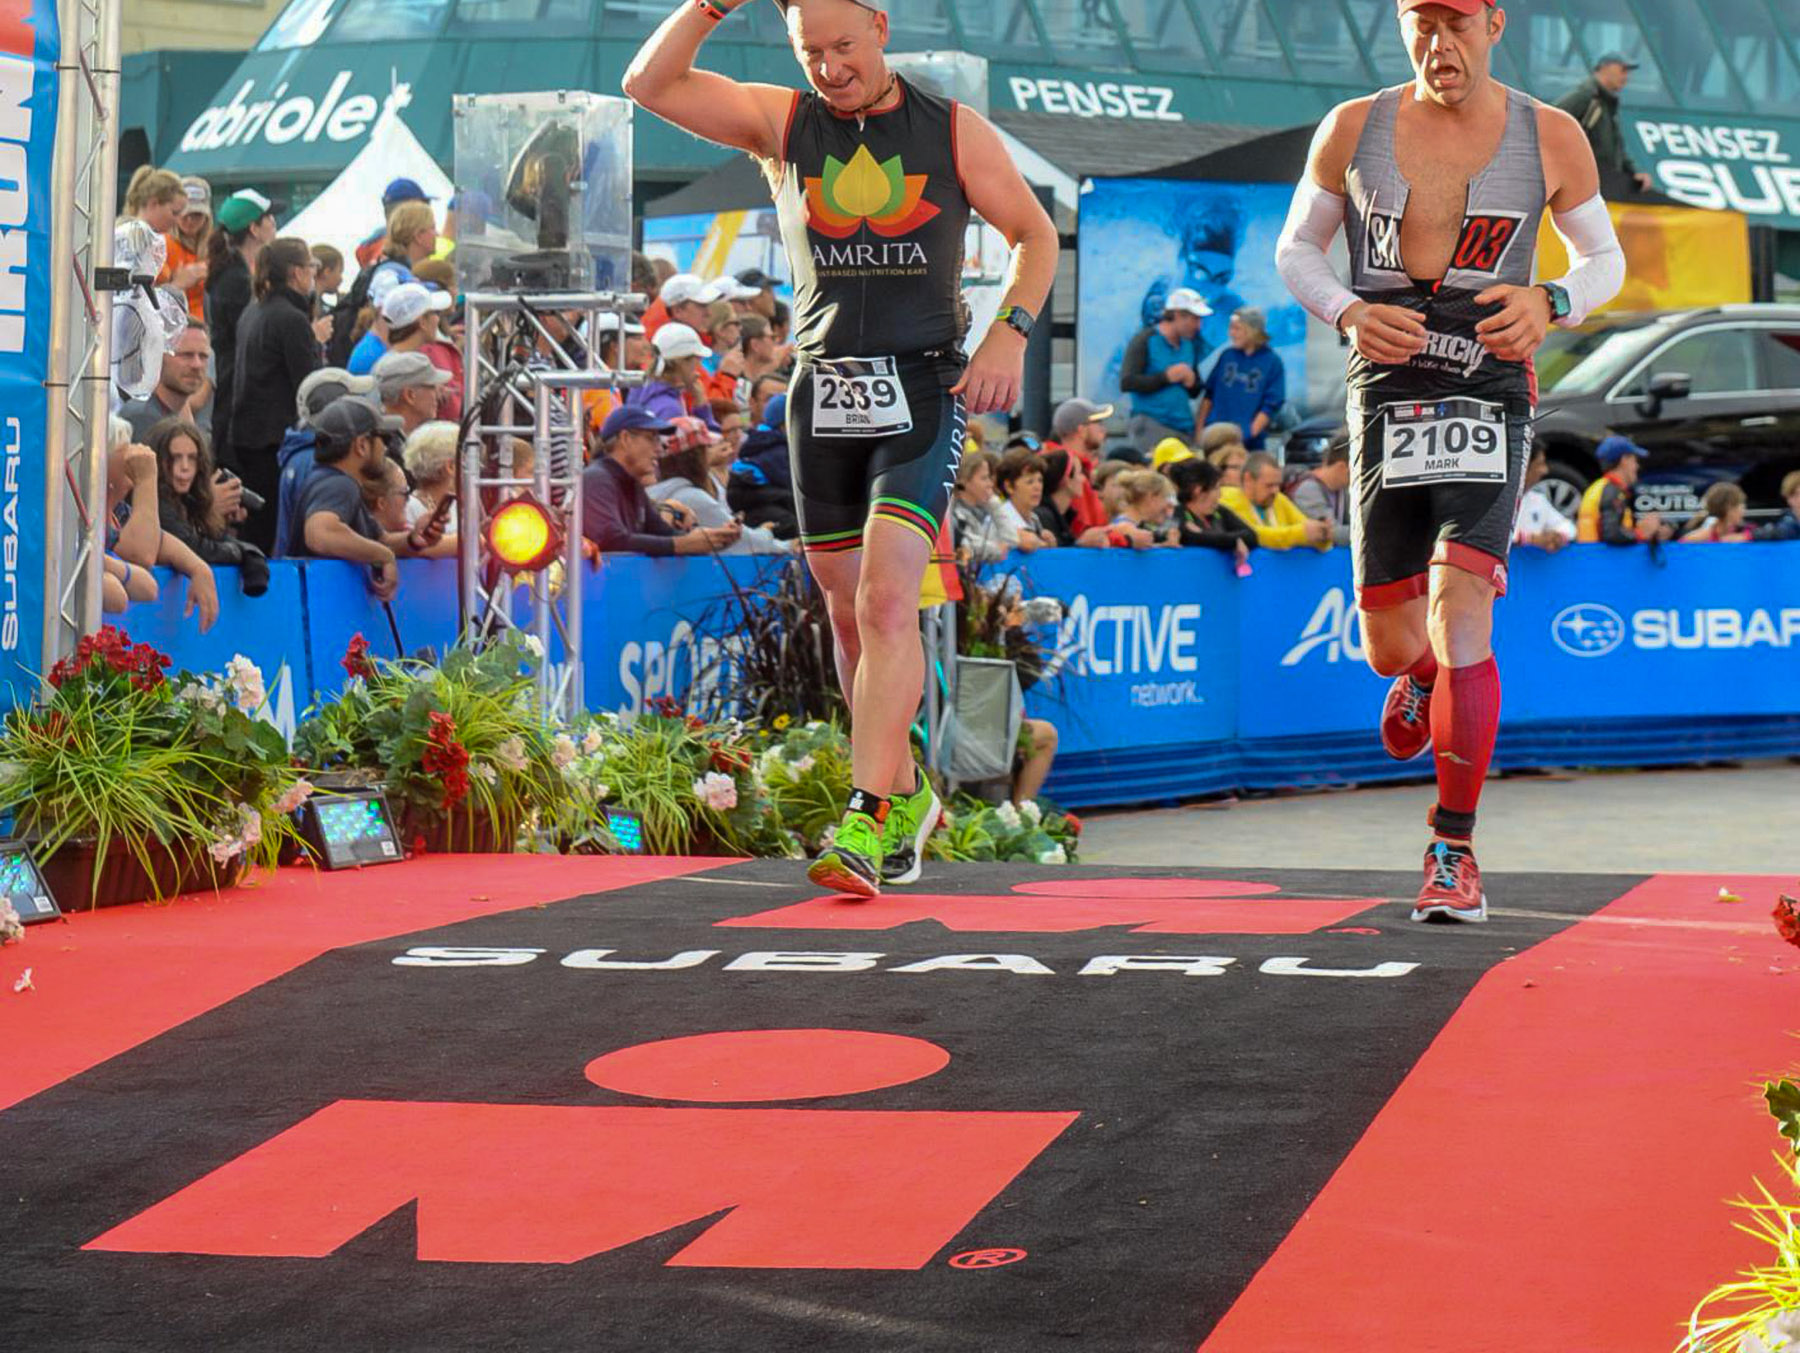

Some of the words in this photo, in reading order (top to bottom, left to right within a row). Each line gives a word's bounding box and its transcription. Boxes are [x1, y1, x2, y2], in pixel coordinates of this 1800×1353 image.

[1008, 76, 1184, 121] PENSEZ
[1635, 120, 1791, 164] PENSEZ
[813, 241, 928, 267] AMRITA
[1391, 421, 1498, 459] 2109
[1424, 458, 1460, 471] MARK
[1, 416, 21, 651] SUBARU
[1040, 593, 1202, 677] ACTIVE
[391, 946, 1422, 982] SUBARU
